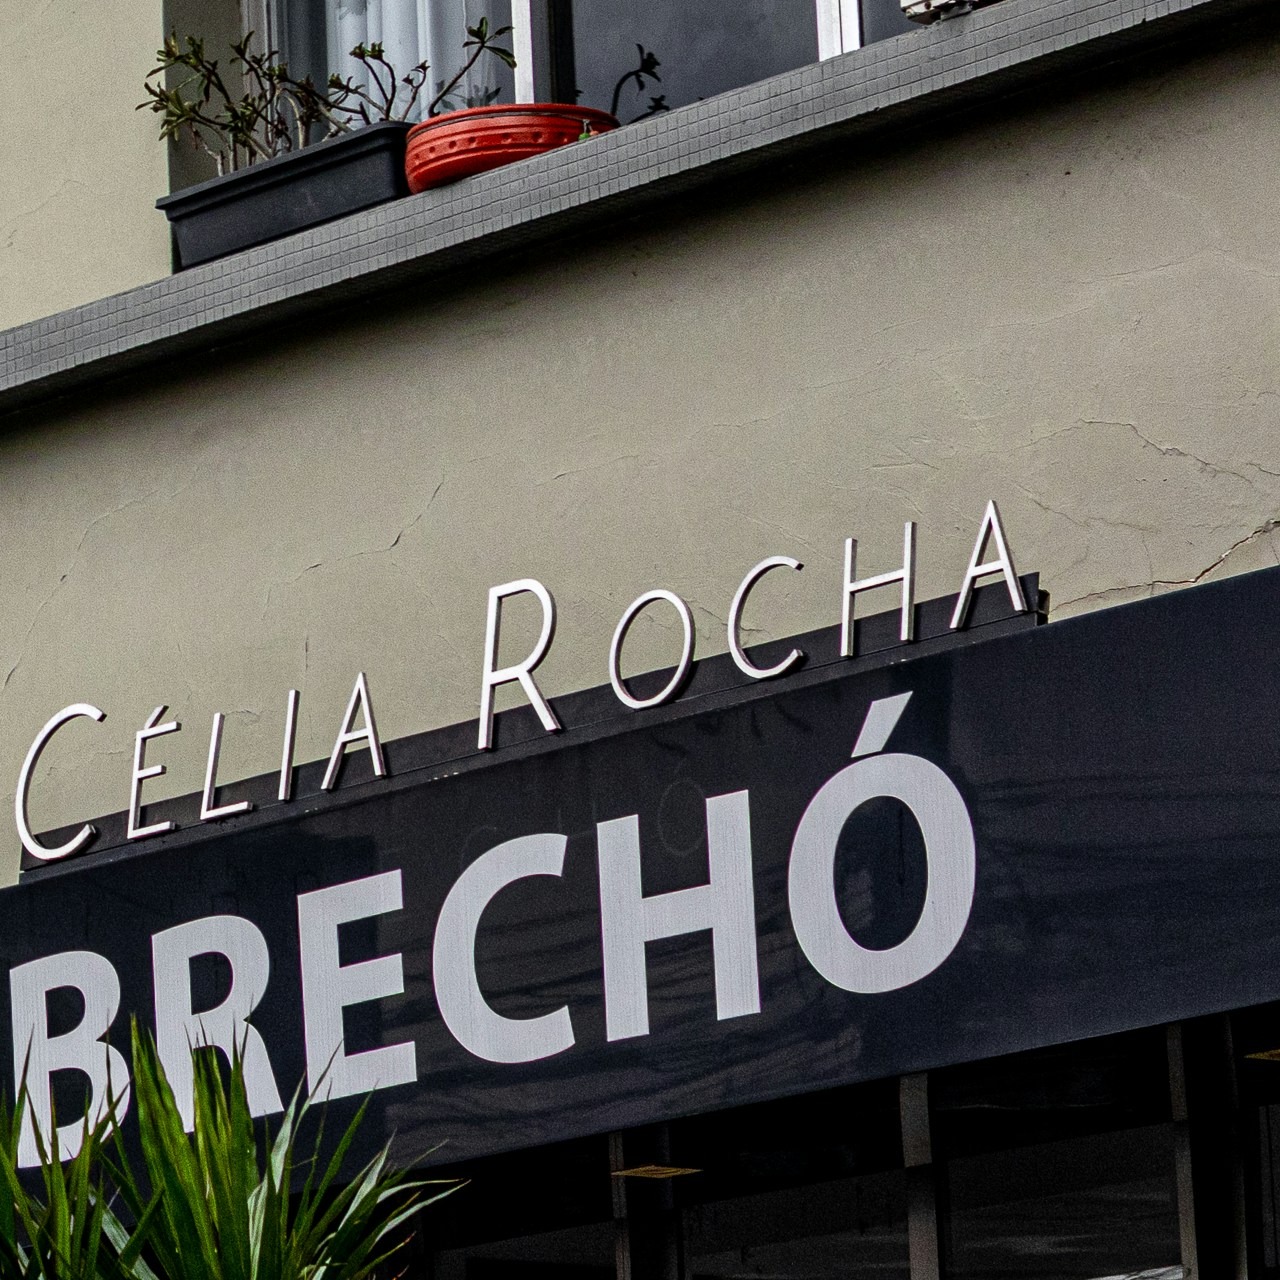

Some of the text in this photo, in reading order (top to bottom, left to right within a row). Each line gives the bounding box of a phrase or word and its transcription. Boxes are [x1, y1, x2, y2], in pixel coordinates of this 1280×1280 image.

[14, 500, 1029, 863] CÉLIA ROCHA
[9, 692, 976, 1169] BRECHÓ
